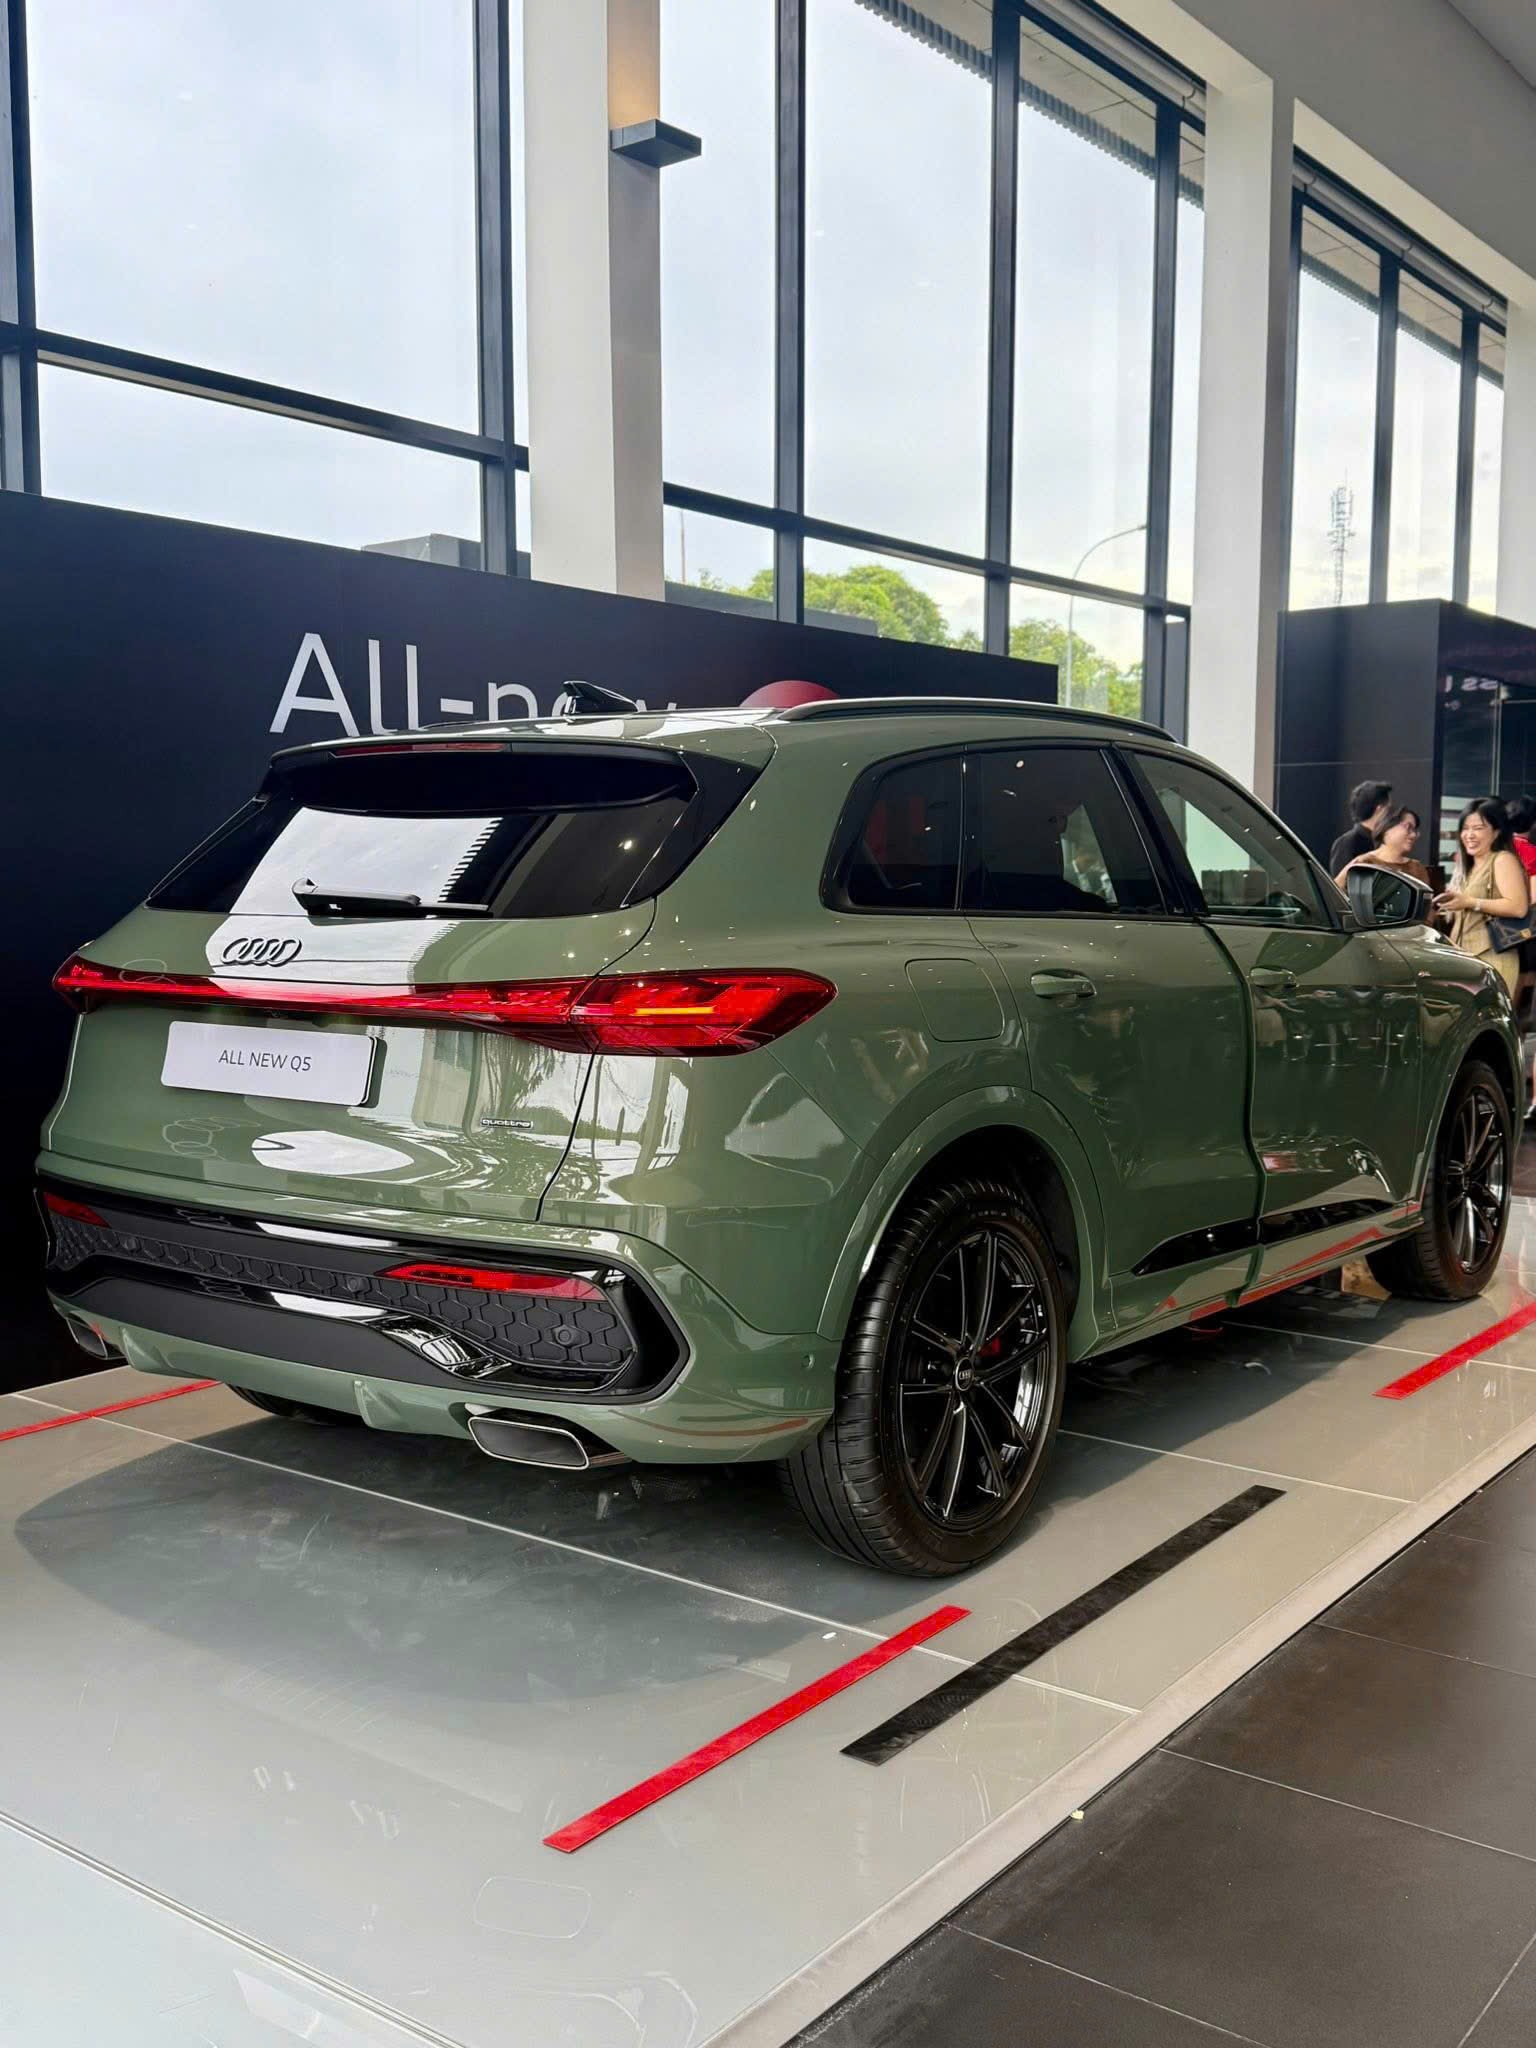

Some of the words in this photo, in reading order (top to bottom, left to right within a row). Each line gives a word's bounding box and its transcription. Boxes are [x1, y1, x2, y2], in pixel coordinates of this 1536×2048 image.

[269, 632, 677, 736] All-n
[218, 1049, 245, 1066] ALL
[249, 1051, 288, 1069] NEW
[290, 1055, 312, 1072] Q5
[482, 1119, 530, 1128] quattro
